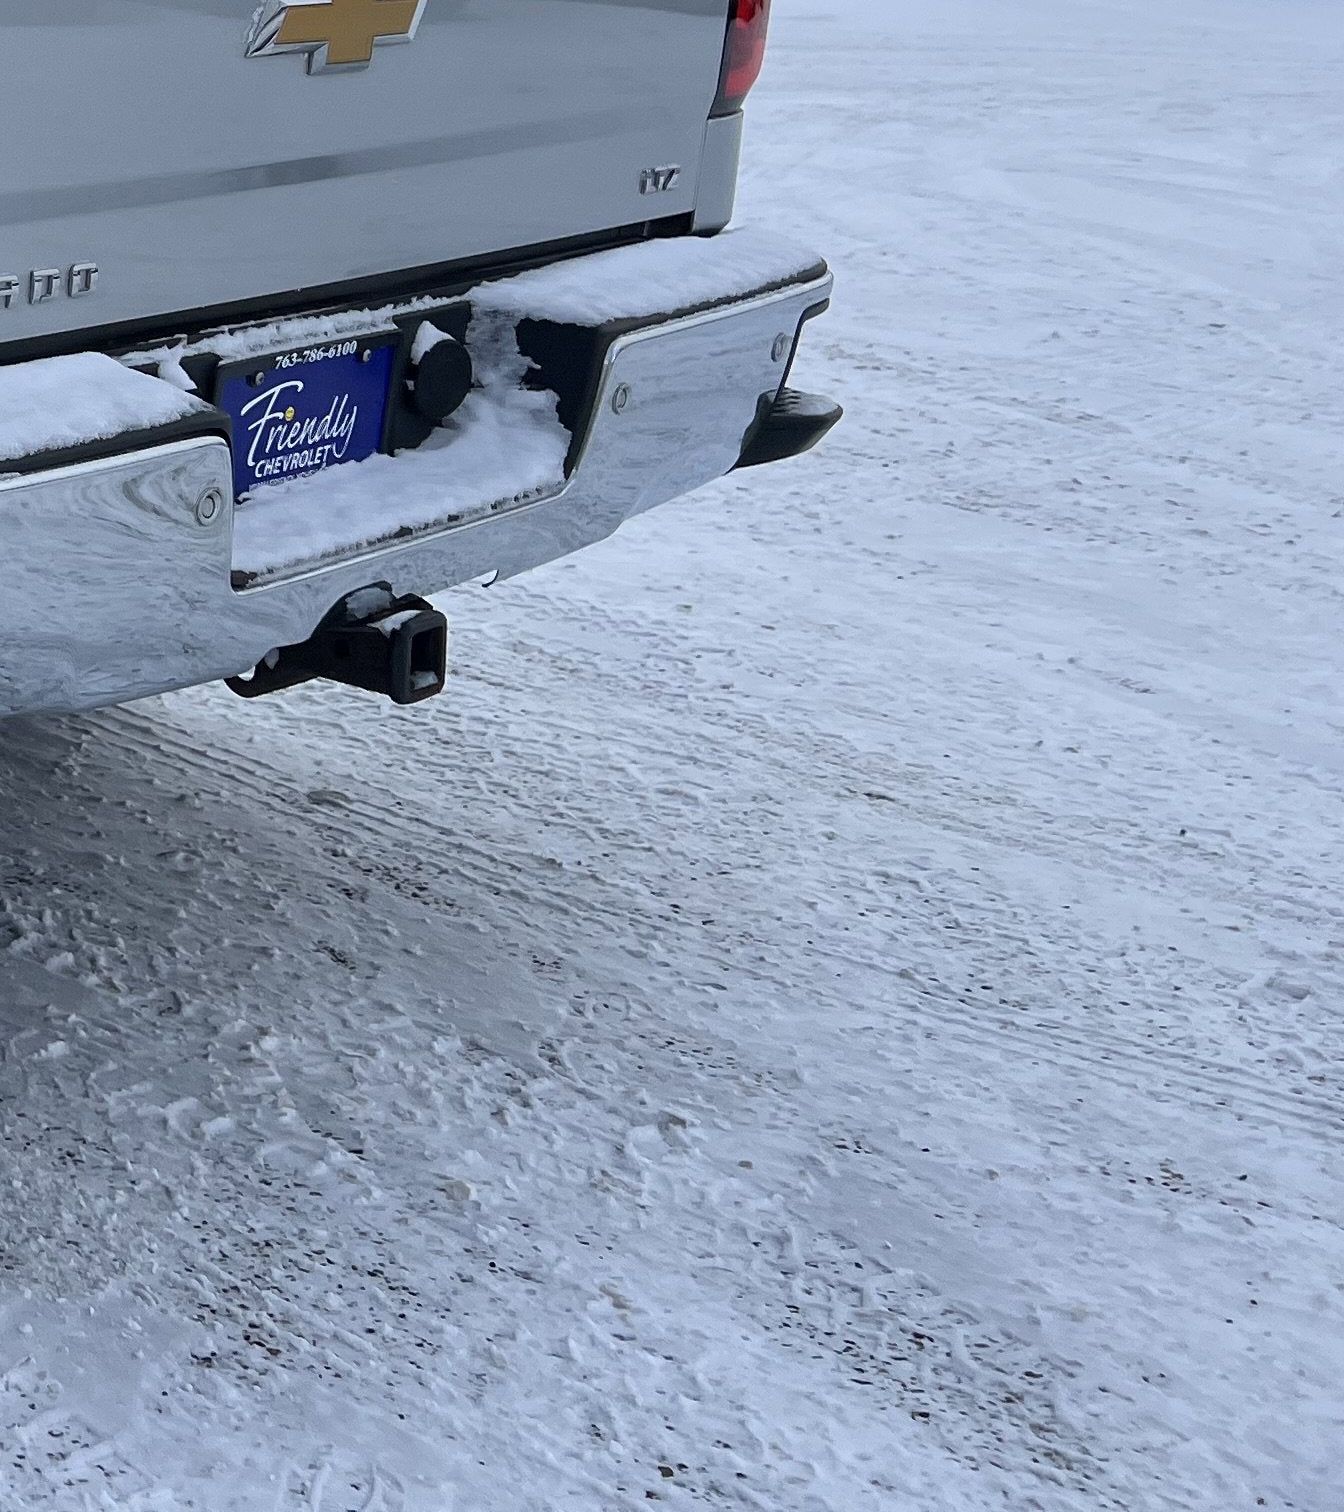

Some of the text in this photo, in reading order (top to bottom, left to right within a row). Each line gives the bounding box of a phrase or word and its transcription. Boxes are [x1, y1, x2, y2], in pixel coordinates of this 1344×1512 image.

[639, 167, 681, 196] LTZ
[274, 340, 358, 370] 763-786-6100
[240, 380, 358, 467] Friendly
[255, 444, 332, 478] CHEVROLET
